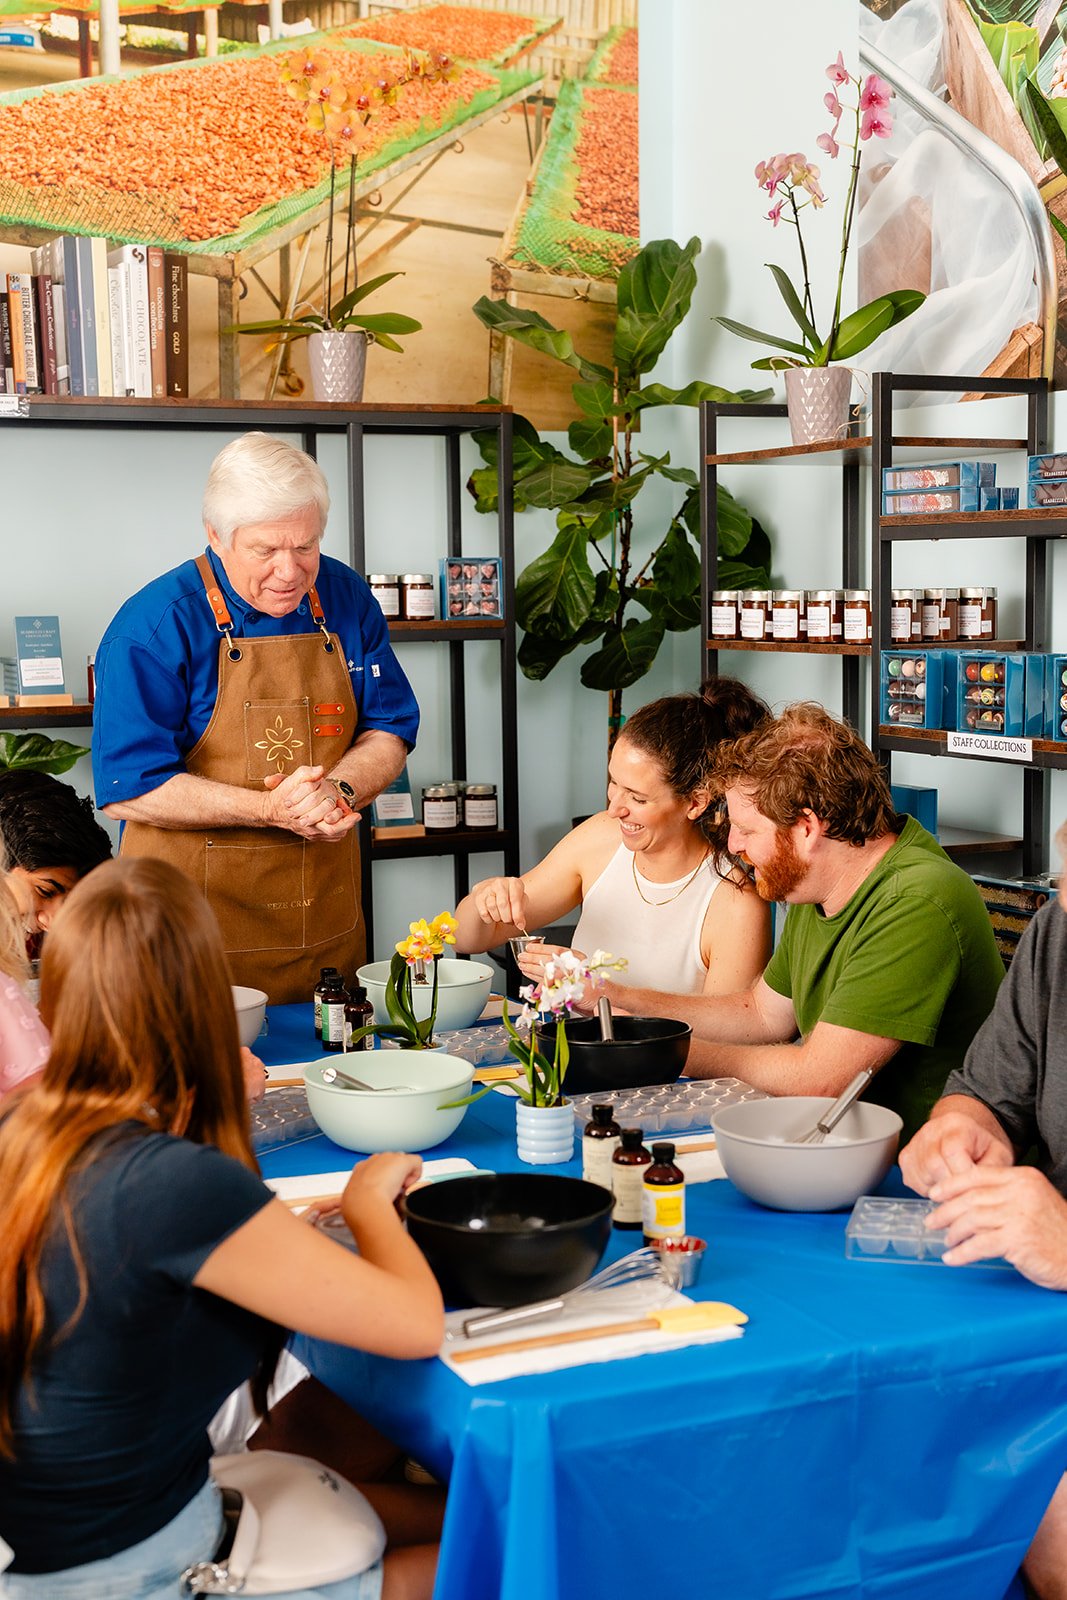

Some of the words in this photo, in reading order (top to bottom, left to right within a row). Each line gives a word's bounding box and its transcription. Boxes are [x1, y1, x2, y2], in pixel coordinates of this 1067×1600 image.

[172, 265, 180, 282] Fine
[21, 287, 29, 308] BITTER
[45, 290, 53, 315] Complete
[172, 283, 180, 323] chocolates
[22, 310, 32, 345] CHOCOLATE
[136, 300, 146, 366] CHOCOLATE
[25, 349, 34, 368] CAROL
[27, 371, 35, 382] OFF
[952, 736, 973, 747] STAFF
[974, 738, 1027, 753] COLLECTIONS
